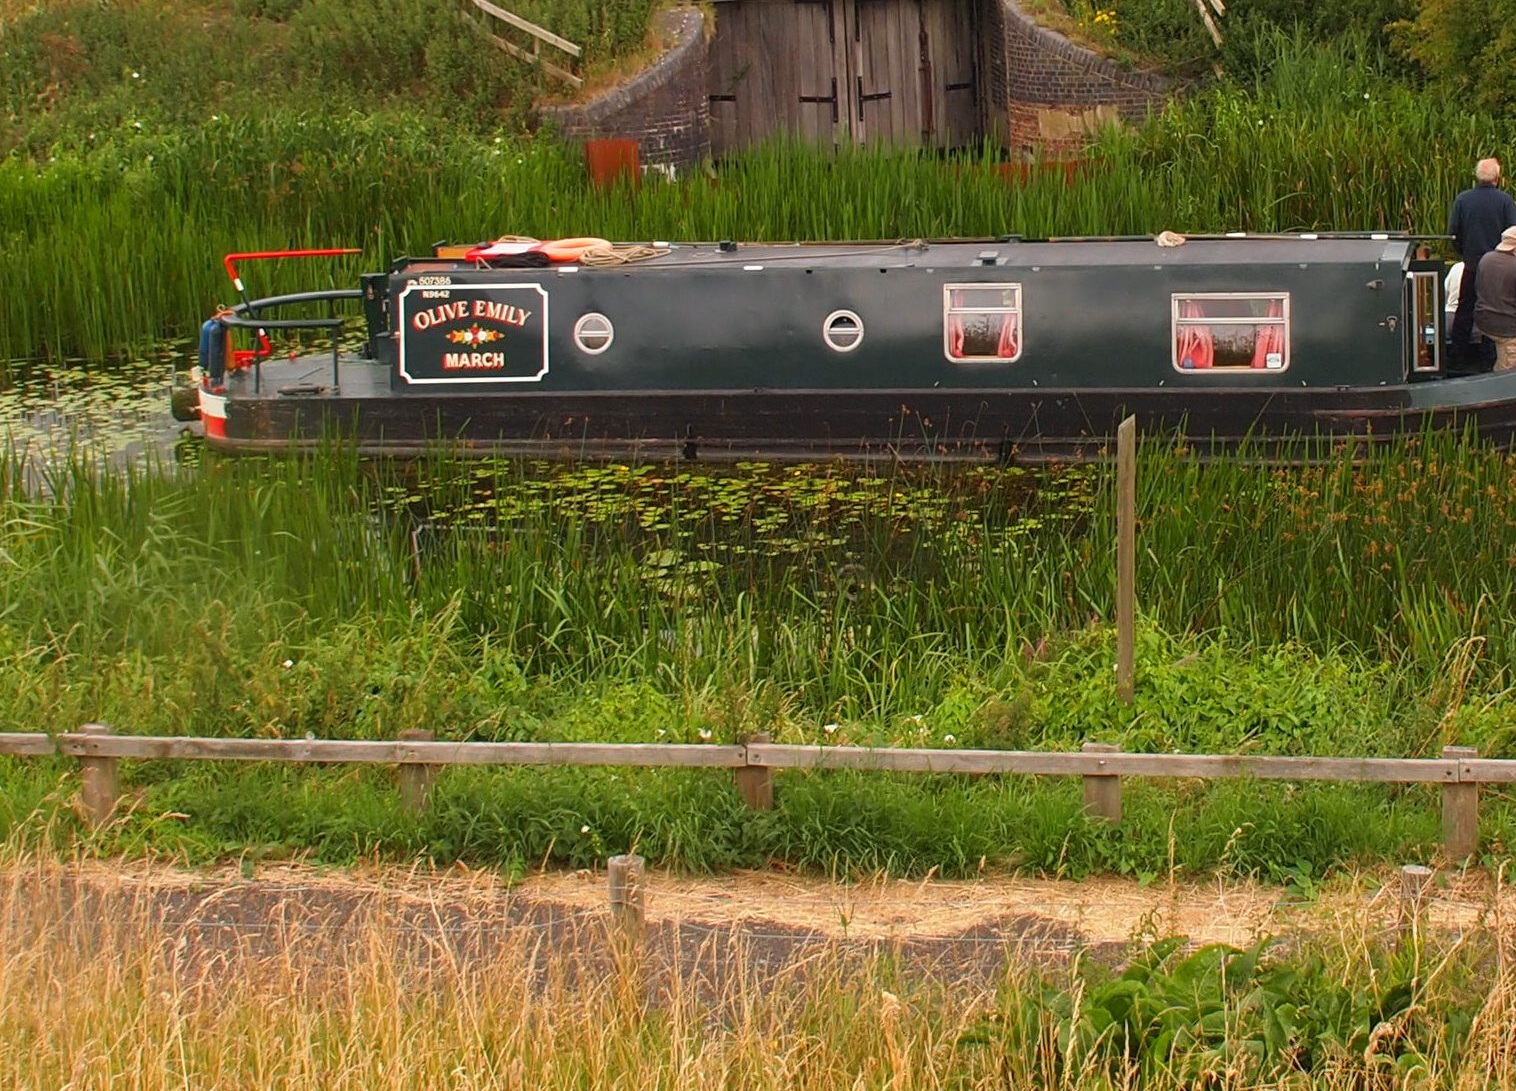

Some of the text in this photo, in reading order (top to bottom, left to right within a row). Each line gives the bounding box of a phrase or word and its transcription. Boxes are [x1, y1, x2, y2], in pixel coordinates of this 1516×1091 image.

[413, 300, 532, 330] OLIVE EMILY
[443, 352, 505, 370] MARCH
